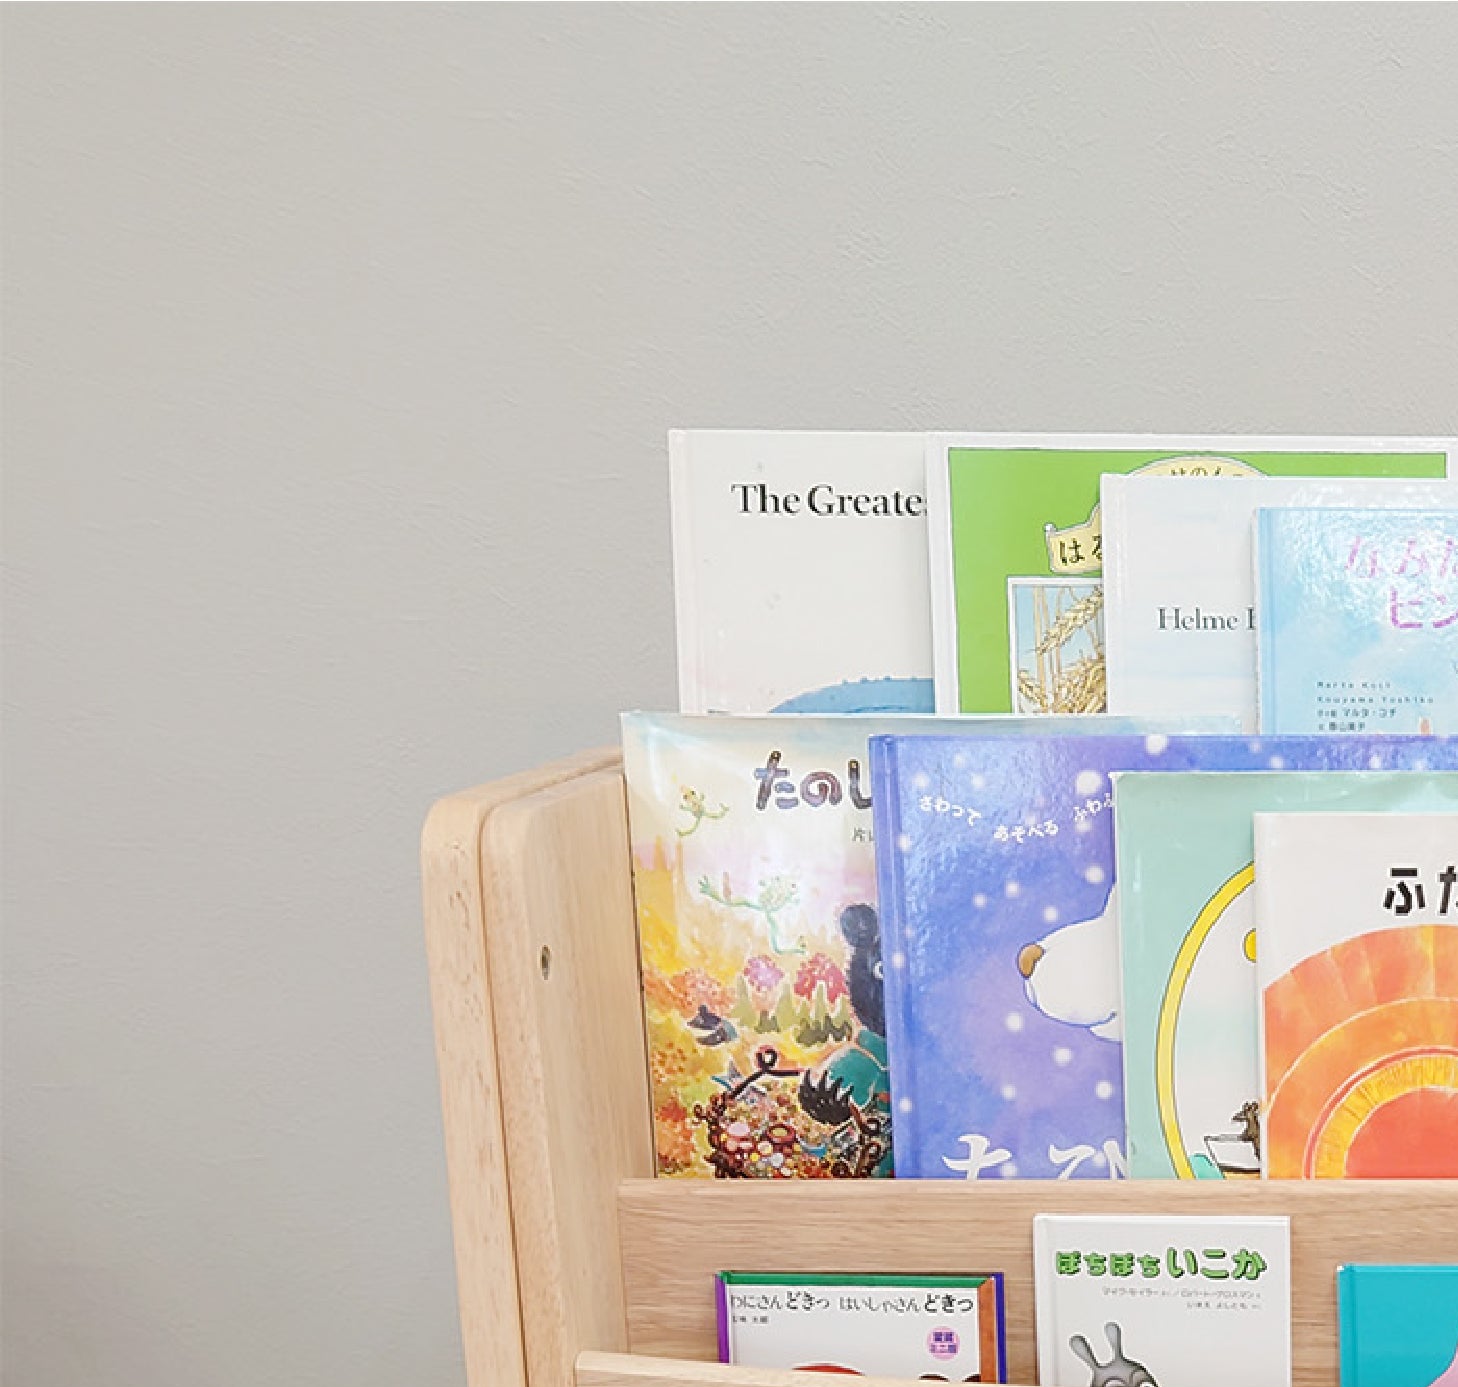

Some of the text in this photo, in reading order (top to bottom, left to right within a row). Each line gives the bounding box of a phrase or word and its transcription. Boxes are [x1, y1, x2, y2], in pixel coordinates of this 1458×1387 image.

[732, 484, 800, 515] The
[1158, 607, 1238, 632] Helme
[918, 795, 983, 827] さわって
[993, 820, 1059, 844] あそべる
[1056, 1247, 1267, 1280] ぼちぼちいこか
